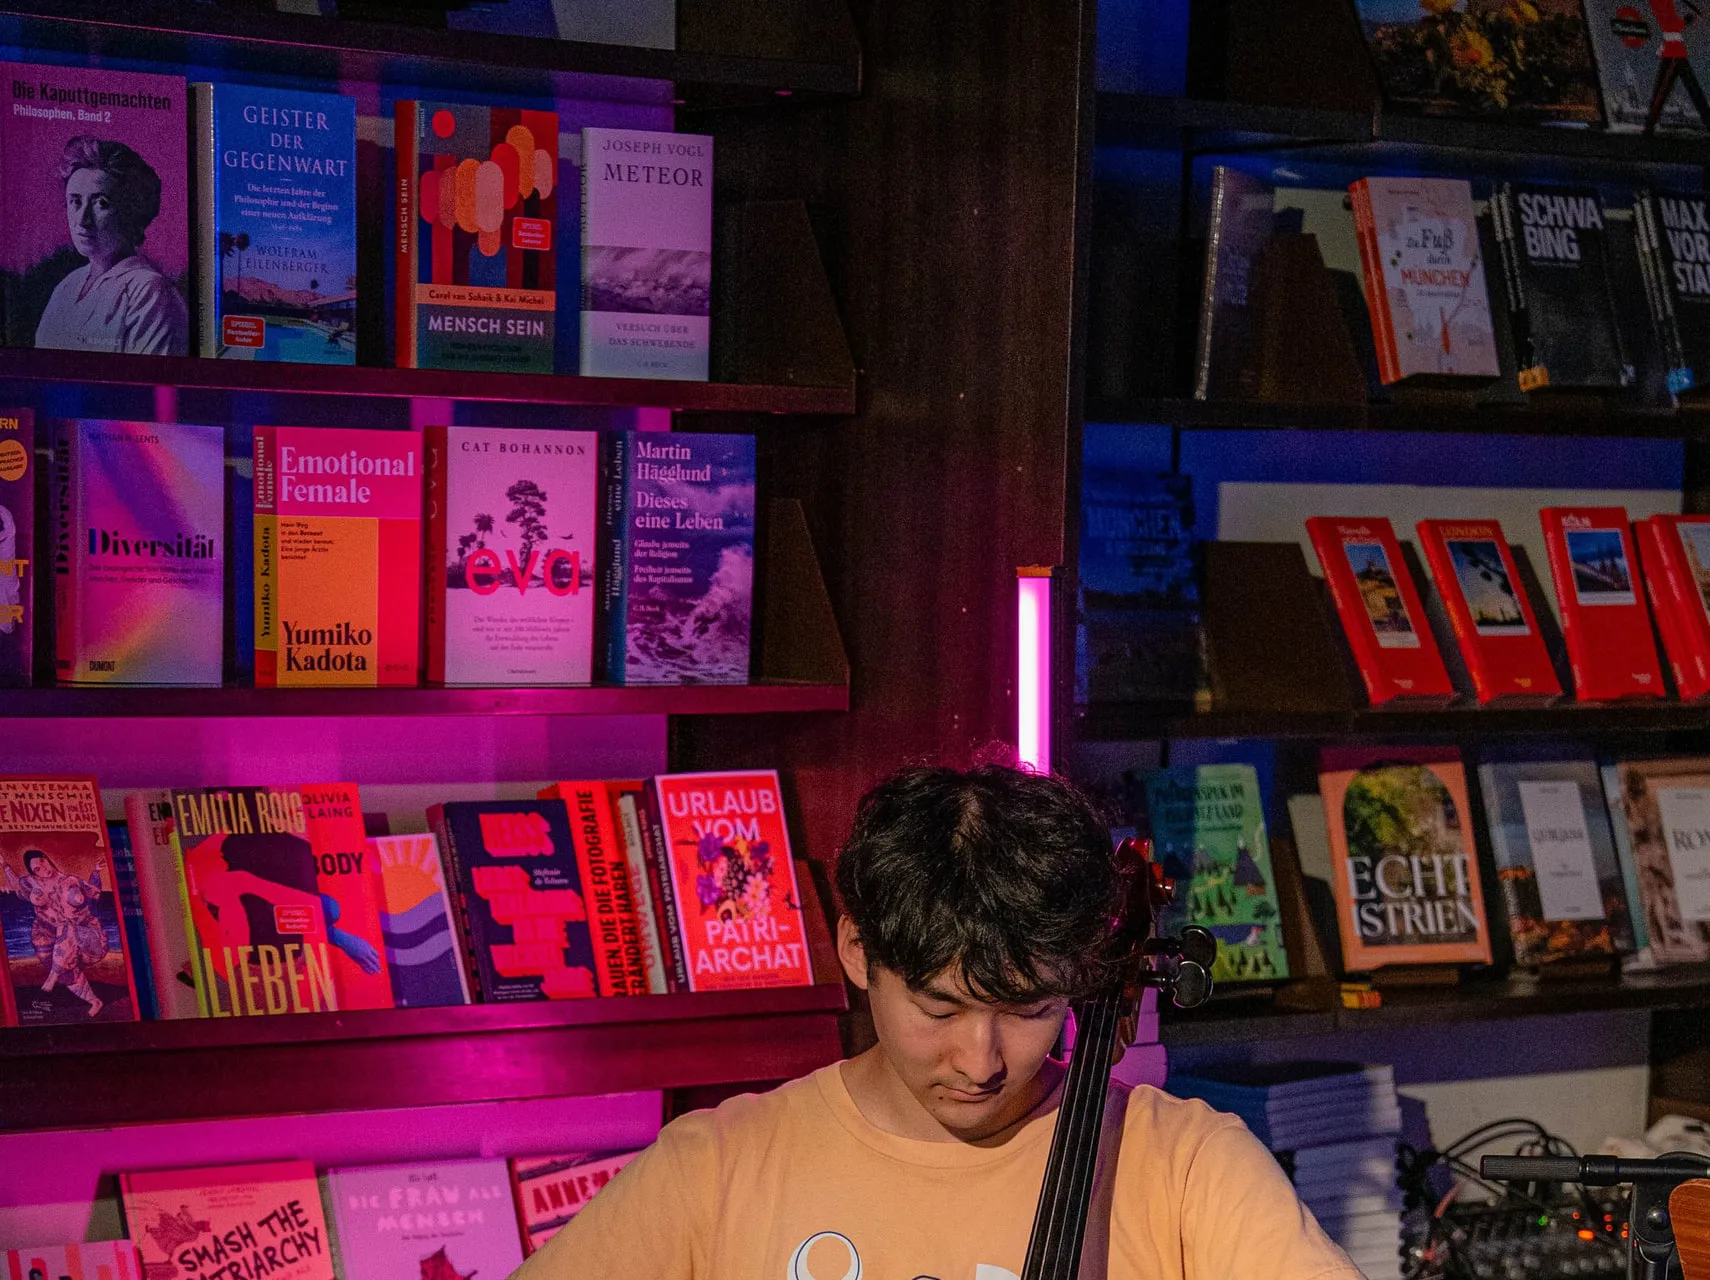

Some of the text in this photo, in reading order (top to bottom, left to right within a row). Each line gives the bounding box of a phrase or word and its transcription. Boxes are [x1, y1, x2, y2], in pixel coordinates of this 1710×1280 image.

[12, 81, 172, 111] Die Kaputtgemachten
[77, 108, 102, 123] Band
[102, 110, 112, 124] 2
[242, 105, 331, 131] GEISTER
[269, 131, 305, 151] DER
[602, 139, 705, 157] JOSEPH VOGL
[222, 150, 348, 178] GEGENWART
[603, 163, 703, 187] METEOR
[400, 178, 409, 254] MENSCH SEIN
[1518, 192, 1604, 231] SCHWA
[1659, 196, 1710, 232] MAX
[257, 246, 318, 260] WOLFRAM
[1522, 225, 1581, 260] BING
[246, 258, 331, 274] EILENBERGER
[428, 289, 451, 299] Carel
[452, 293, 466, 301] van
[467, 292, 494, 302] Schaik
[428, 315, 545, 336] MENSCH SEIN
[281, 446, 414, 477] Emotional
[461, 441, 586, 456] CAT BOHANNON
[636, 441, 691, 460] Martin
[255, 436, 265, 509] Emotional
[264, 460, 273, 509] Female
[636, 462, 711, 484] Hägglund
[281, 475, 371, 503] Female
[635, 490, 690, 509] Dieses
[634, 512, 724, 530] eine Leben
[88, 528, 214, 559] Diversität
[261, 527, 271, 638] Yumiko Kadota
[465, 548, 580, 597] eva
[282, 620, 372, 647] Yumiko
[285, 647, 367, 672] Kadota
[15, 792, 93, 800] MENSCHIK
[21, 783, 90, 791] VETEMAA
[301, 791, 352, 806] OLIVIA
[9, 800, 67, 822] NIXEN
[175, 792, 255, 837] EMILIA
[254, 790, 307, 835] ROIG
[308, 805, 354, 819] LAING
[667, 789, 777, 818] URLAUB
[68, 812, 97, 823] LAND
[577, 789, 608, 885] FOTOGRAFIE
[692, 818, 761, 844] VOM
[610, 861, 634, 914] HABEN
[1346, 852, 1471, 900] ECHT
[597, 890, 615, 914] DIE
[601, 919, 619, 944] DIE
[704, 916, 790, 945] PATRI-
[1350, 901, 1480, 938] ISTRIEN
[695, 943, 800, 975] ARCHAT
[202, 941, 339, 1019] LIEBEN
[388, 1185, 461, 1210] FRAU
[177, 1200, 310, 1272] SMASH THE
